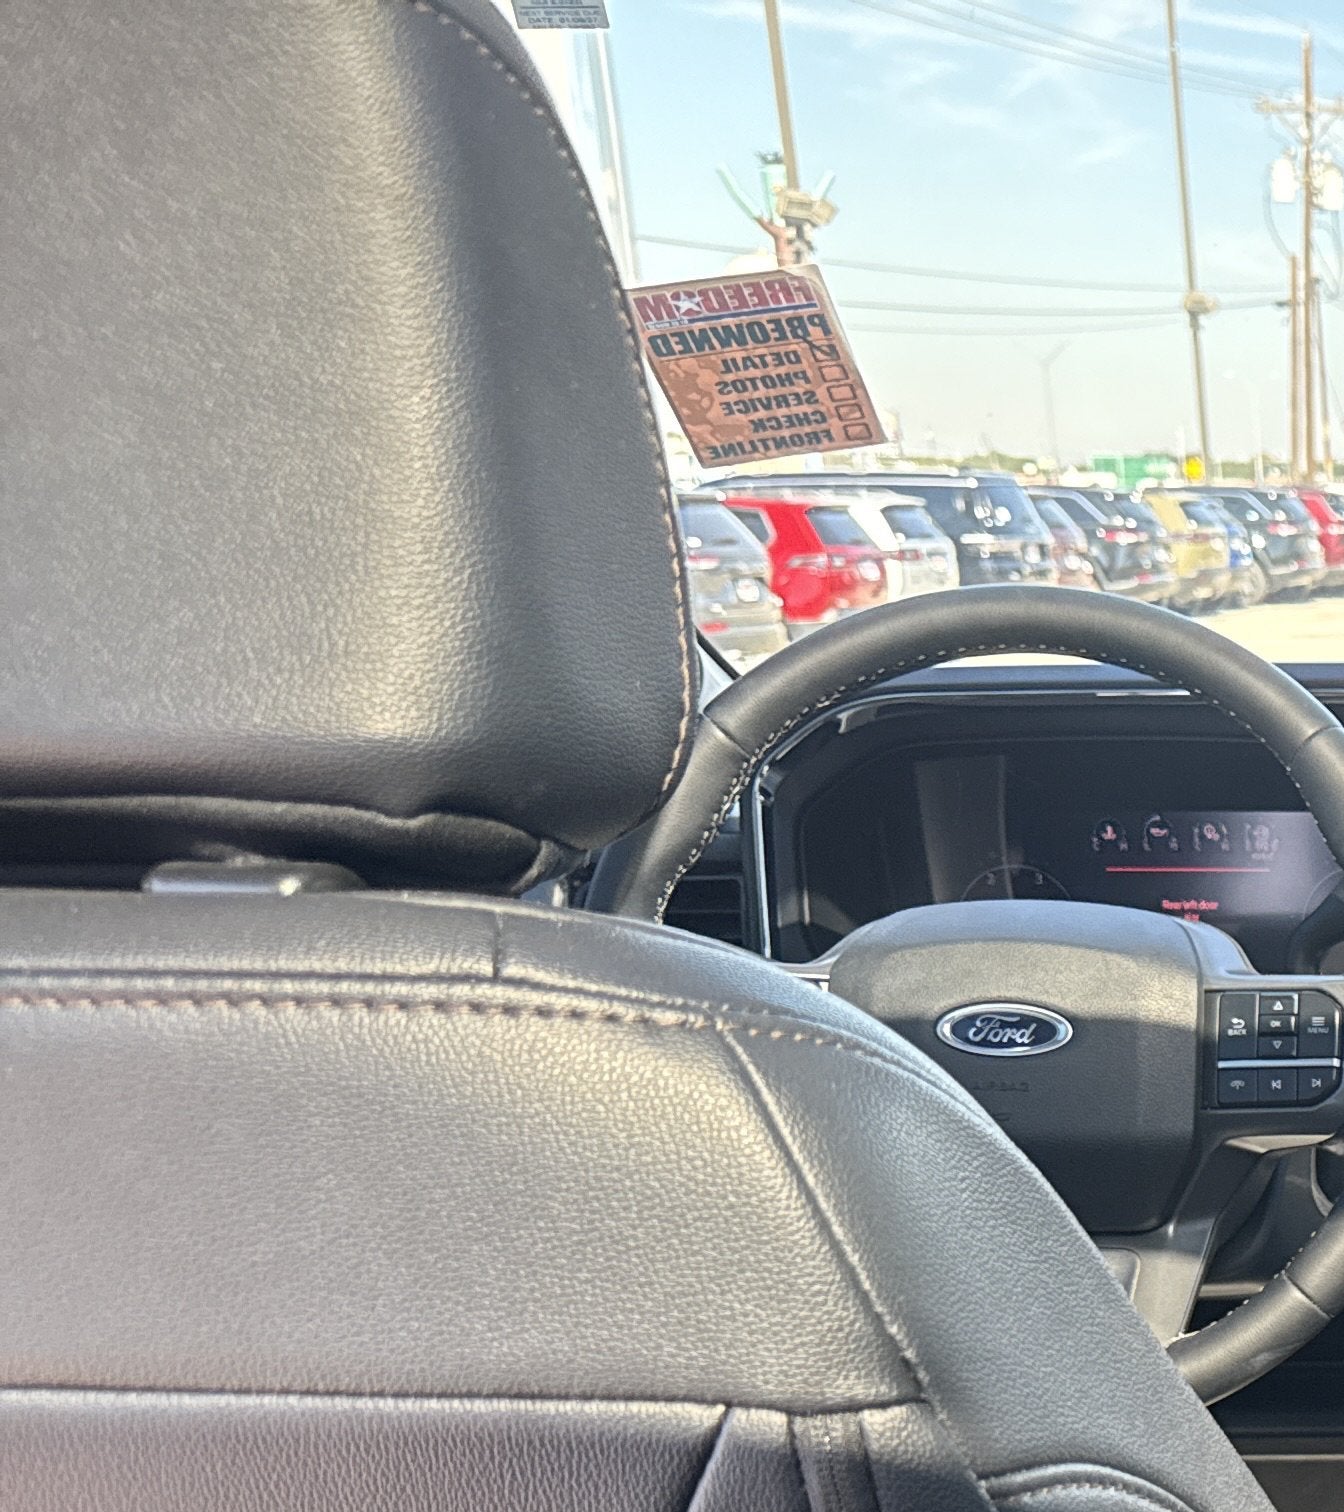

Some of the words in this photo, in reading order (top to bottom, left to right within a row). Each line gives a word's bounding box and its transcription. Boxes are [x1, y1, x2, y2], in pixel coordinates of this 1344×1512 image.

[968, 1013, 1035, 1044] Ford
[1227, 1028, 1247, 1036] BACK
[1307, 1026, 1329, 1034] MENU
